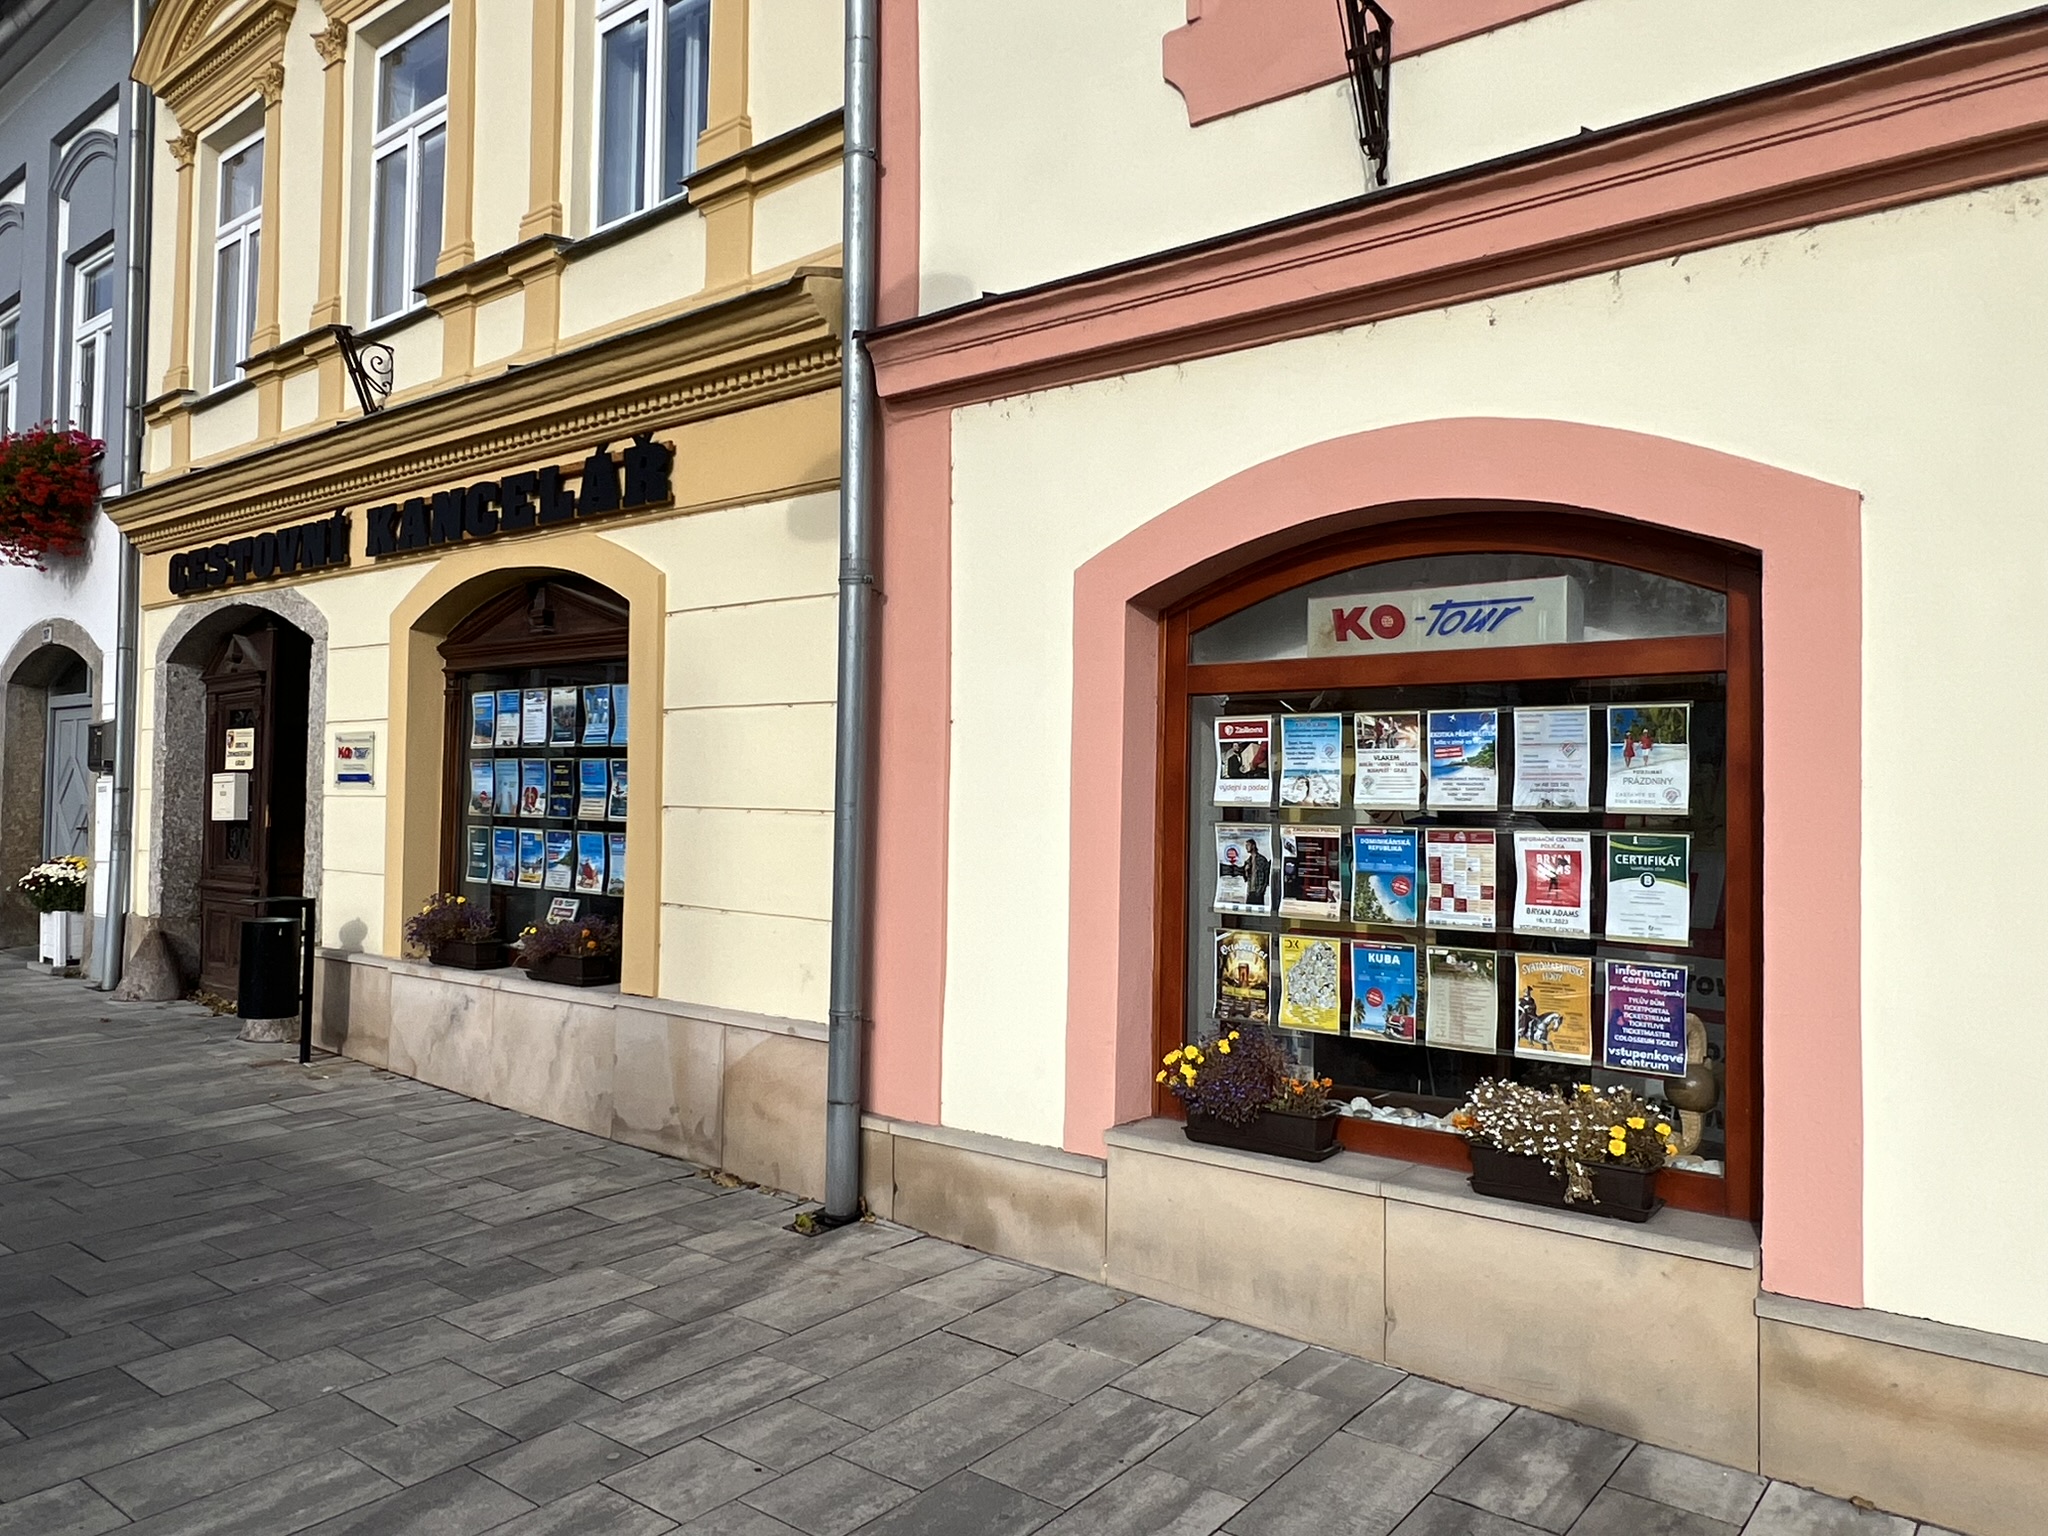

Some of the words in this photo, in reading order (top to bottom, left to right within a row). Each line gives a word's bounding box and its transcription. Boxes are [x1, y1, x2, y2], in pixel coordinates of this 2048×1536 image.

[168, 508, 350, 597] CESTOVNÍ
[366, 432, 673, 557] KANCELÁŘ
[1622, 775, 1674, 786] PRÁZDNINY
[1360, 837, 1411, 847] DOMINIKÁNSKÁ
[1614, 853, 1682, 867] CERTIFIKÁT
[1526, 907, 1551, 915] BRYAN
[1552, 909, 1579, 918] ADAMS
[1368, 952, 1401, 966] KUBA
[1614, 964, 1680, 981] informační
[1621, 975, 1671, 988] centrum
[1649, 988, 1686, 999] vstupenky
[1623, 1004, 1671, 1015] TICKETPORTAL
[1623, 1011, 1671, 1023] TICKETSTREAM
[1628, 1019, 1665, 1030] TICKETLIVE
[1621, 1026, 1671, 1039] TICKETMASTER
[1613, 1034, 1655, 1045] COLOSSEUM
[1655, 1038, 1679, 1048] TICKET
[1608, 1047, 1684, 1064] vstupenkové
[1620, 1058, 1670, 1071] centrum
